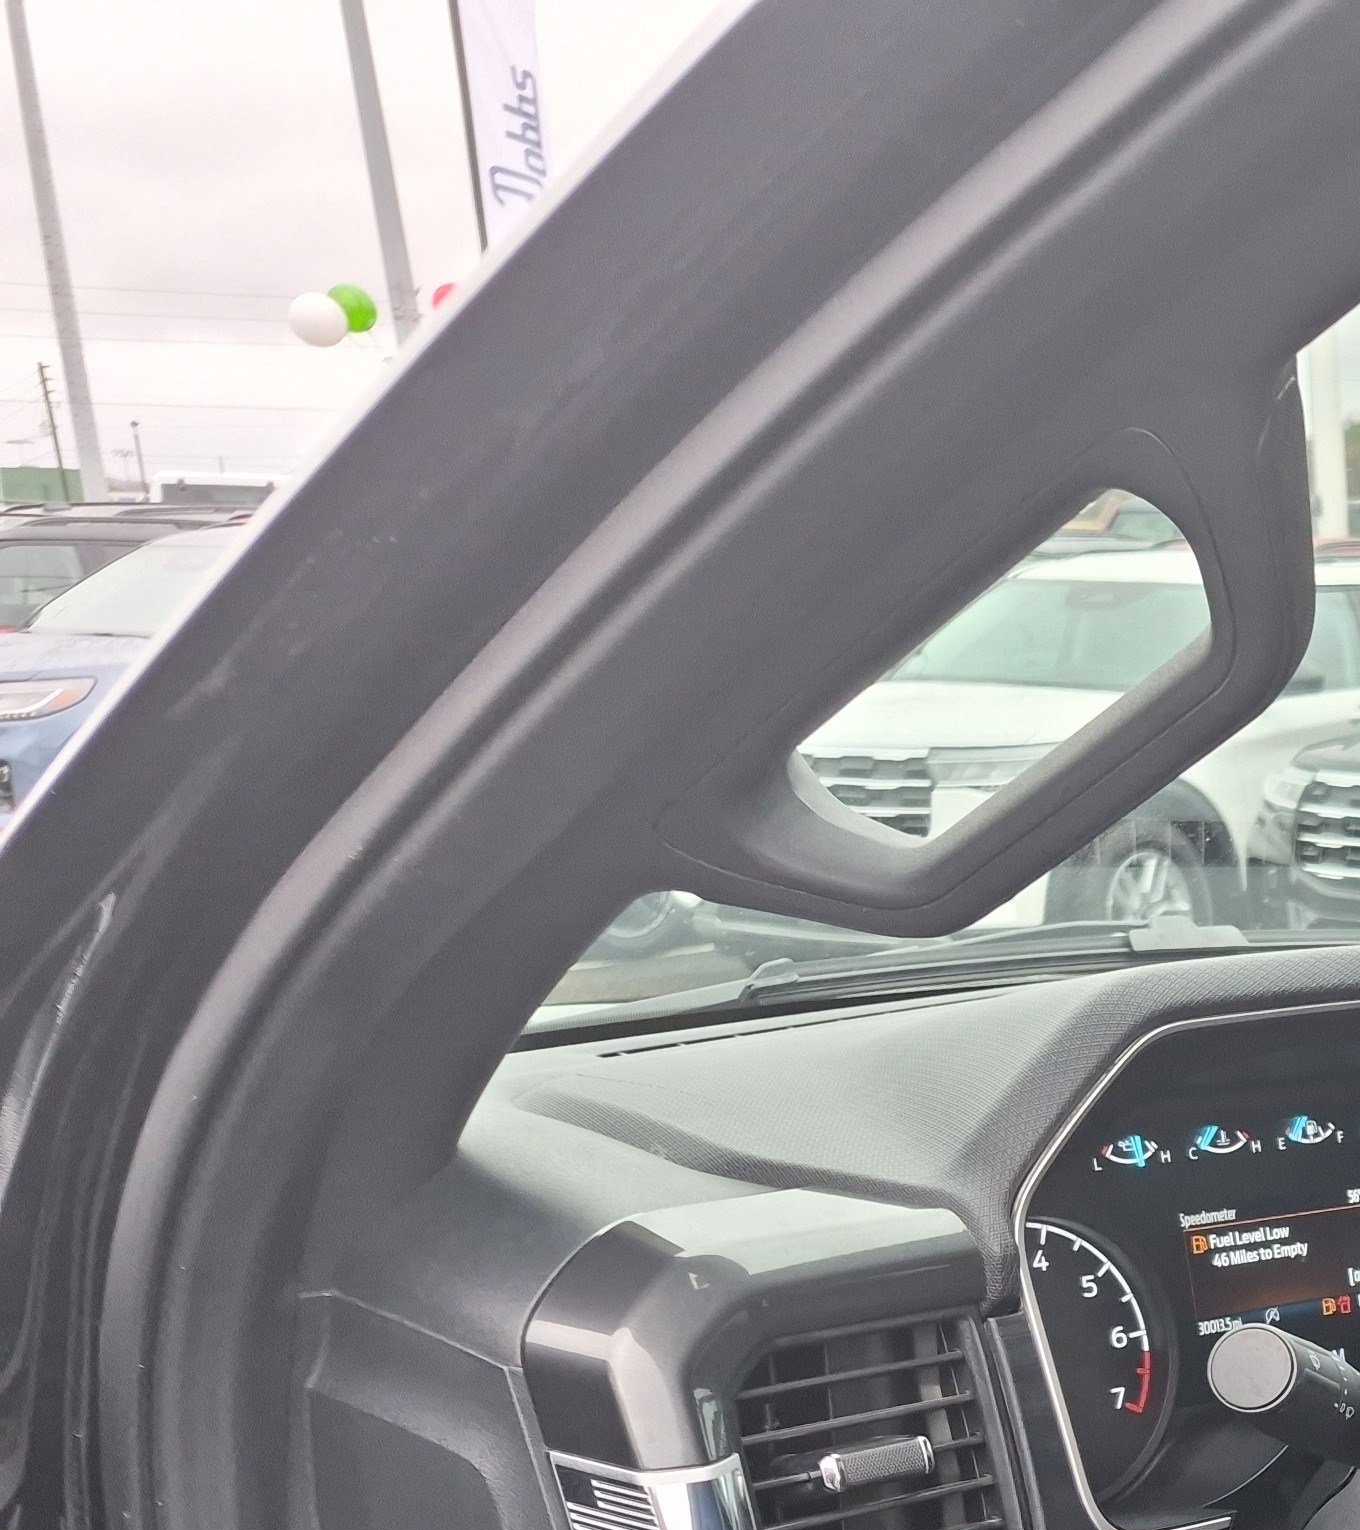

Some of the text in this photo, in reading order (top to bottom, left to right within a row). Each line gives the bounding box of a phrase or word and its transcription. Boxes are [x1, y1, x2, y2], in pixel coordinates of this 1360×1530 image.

[1188, 1140, 1261, 1160] C H
[1277, 1131, 1344, 1150] E F
[1093, 1150, 1171, 1171] L H
[1179, 1208, 1236, 1229] Speedometer
[1209, 1226, 1290, 1249] Fuel Level Low
[1032, 1250, 1049, 1271] 4
[1212, 1242, 1308, 1267] 46 Miles to Empty
[1081, 1275, 1098, 1298] 5
[1111, 1326, 1128, 1348] 6
[1110, 1387, 1125, 1409] 7
